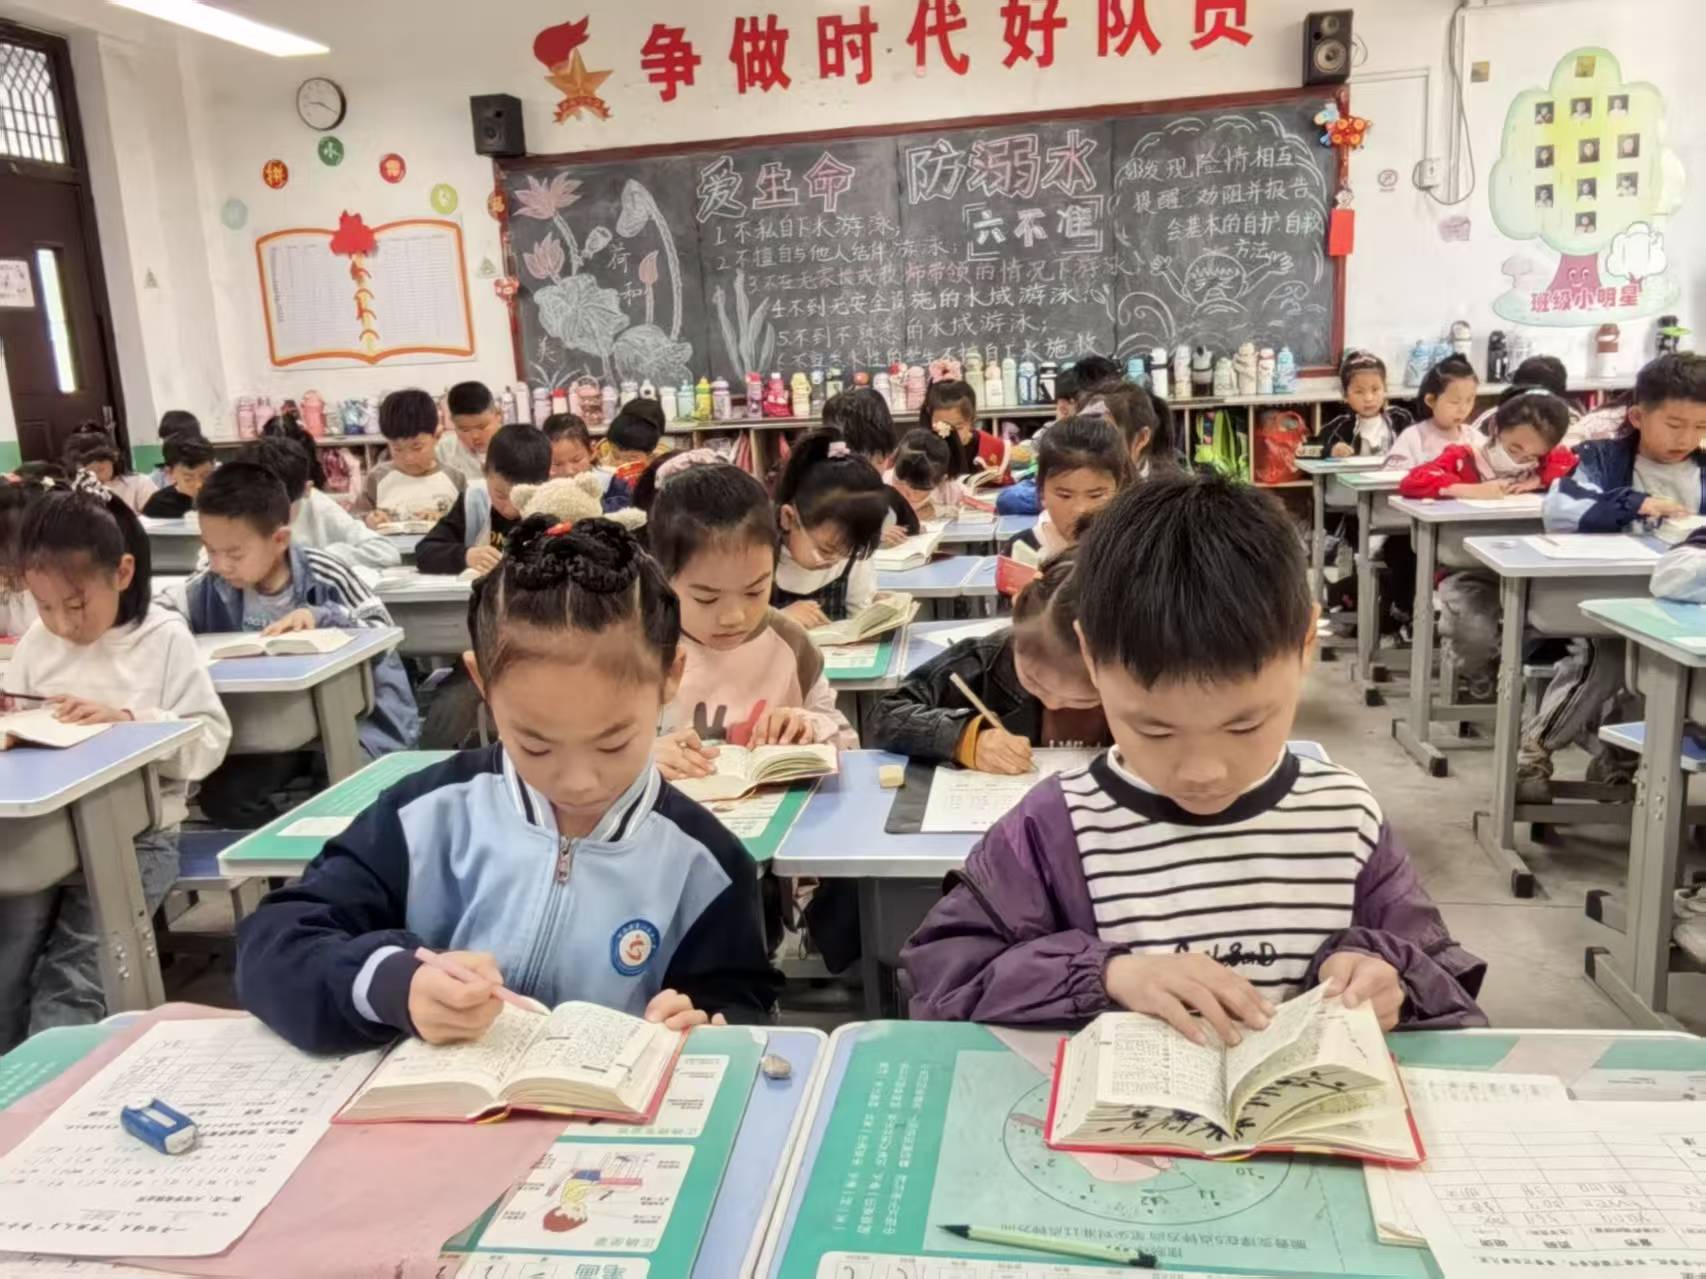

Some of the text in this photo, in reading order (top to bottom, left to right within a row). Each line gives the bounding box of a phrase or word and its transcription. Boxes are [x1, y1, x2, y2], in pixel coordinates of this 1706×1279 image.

[639, 0, 1255, 101] 争做时代好队员
[696, 151, 856, 223] 爱生命
[905, 129, 1098, 204] 防溺水
[1530, 284, 1639, 313] 班级小明星
